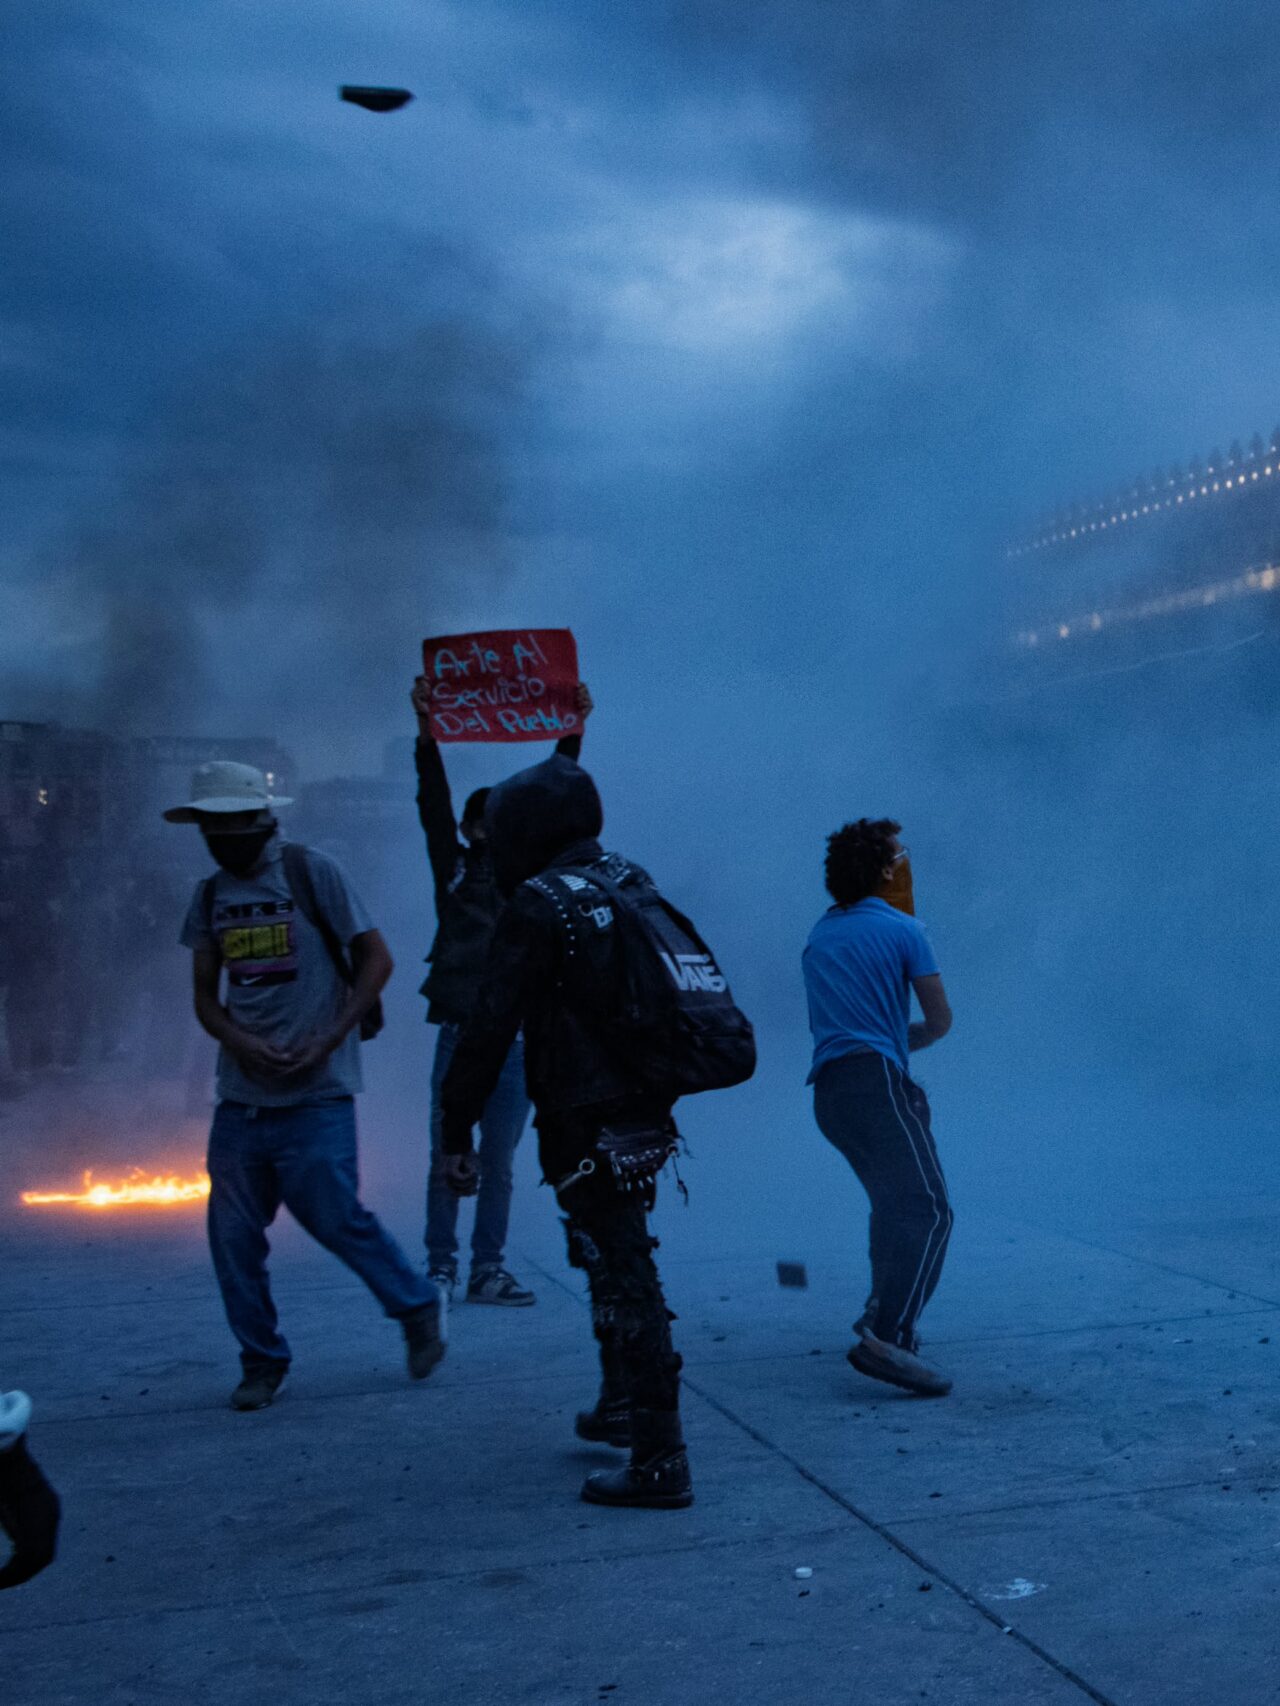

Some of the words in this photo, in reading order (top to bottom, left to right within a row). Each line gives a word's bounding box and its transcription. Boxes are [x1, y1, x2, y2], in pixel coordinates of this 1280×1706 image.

[433, 640, 501, 680] Arte
[512, 632, 549, 670] Al
[431, 672, 546, 710] Servicio
[433, 709, 491, 736] Del
[496, 703, 578, 735] Pueblo
[658, 951, 727, 993] VANS
